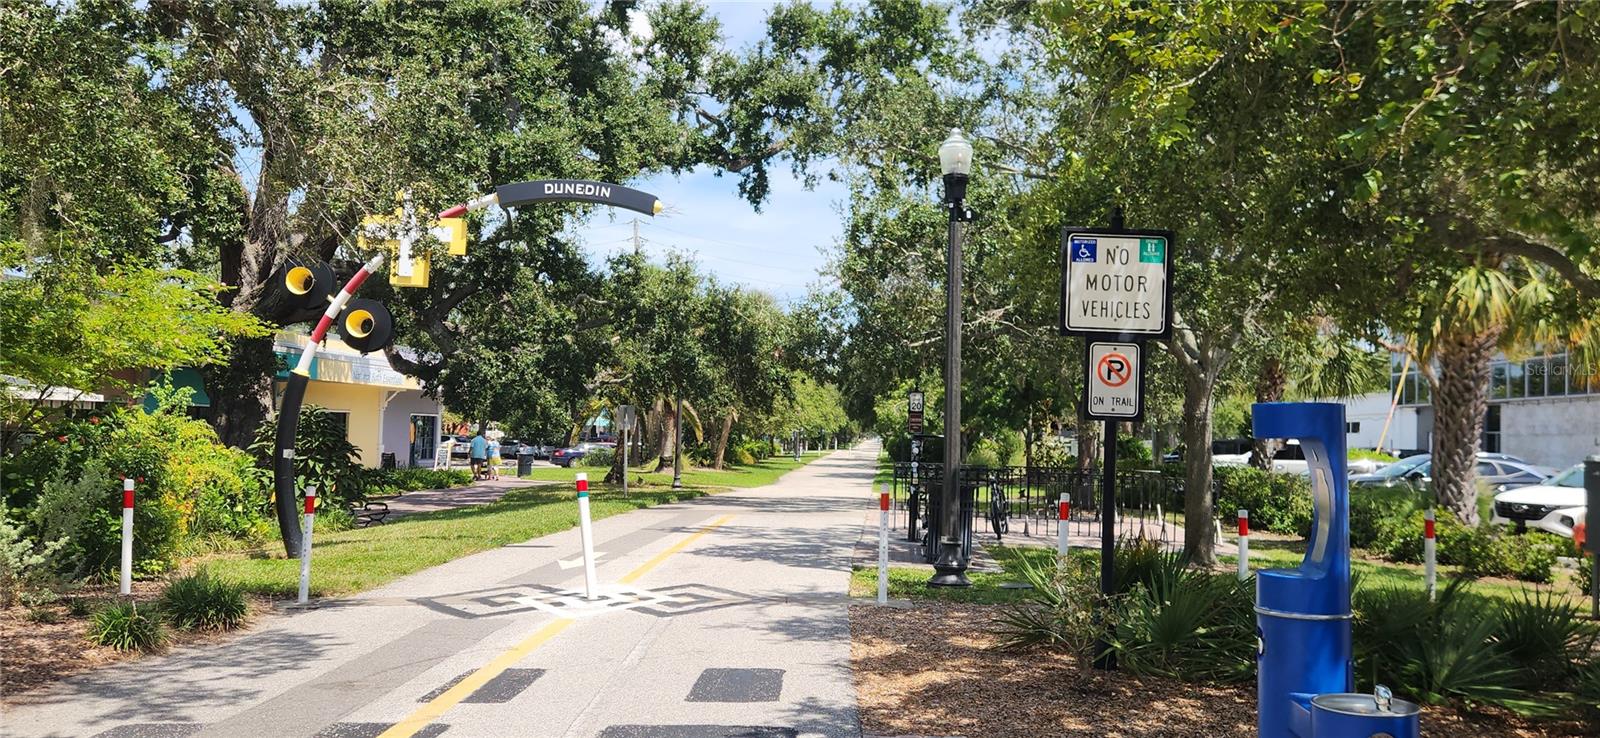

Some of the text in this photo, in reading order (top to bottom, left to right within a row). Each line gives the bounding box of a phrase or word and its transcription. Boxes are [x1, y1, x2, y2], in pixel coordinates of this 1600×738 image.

[544, 183, 611, 198] DUNEDIN
[1106, 248, 1129, 265] NO
[1086, 274, 1147, 292] MOTOR
[1082, 300, 1150, 320] VEHICLES
[911, 402, 921, 410] 20
[1093, 396, 1134, 407] ON TRAIL
